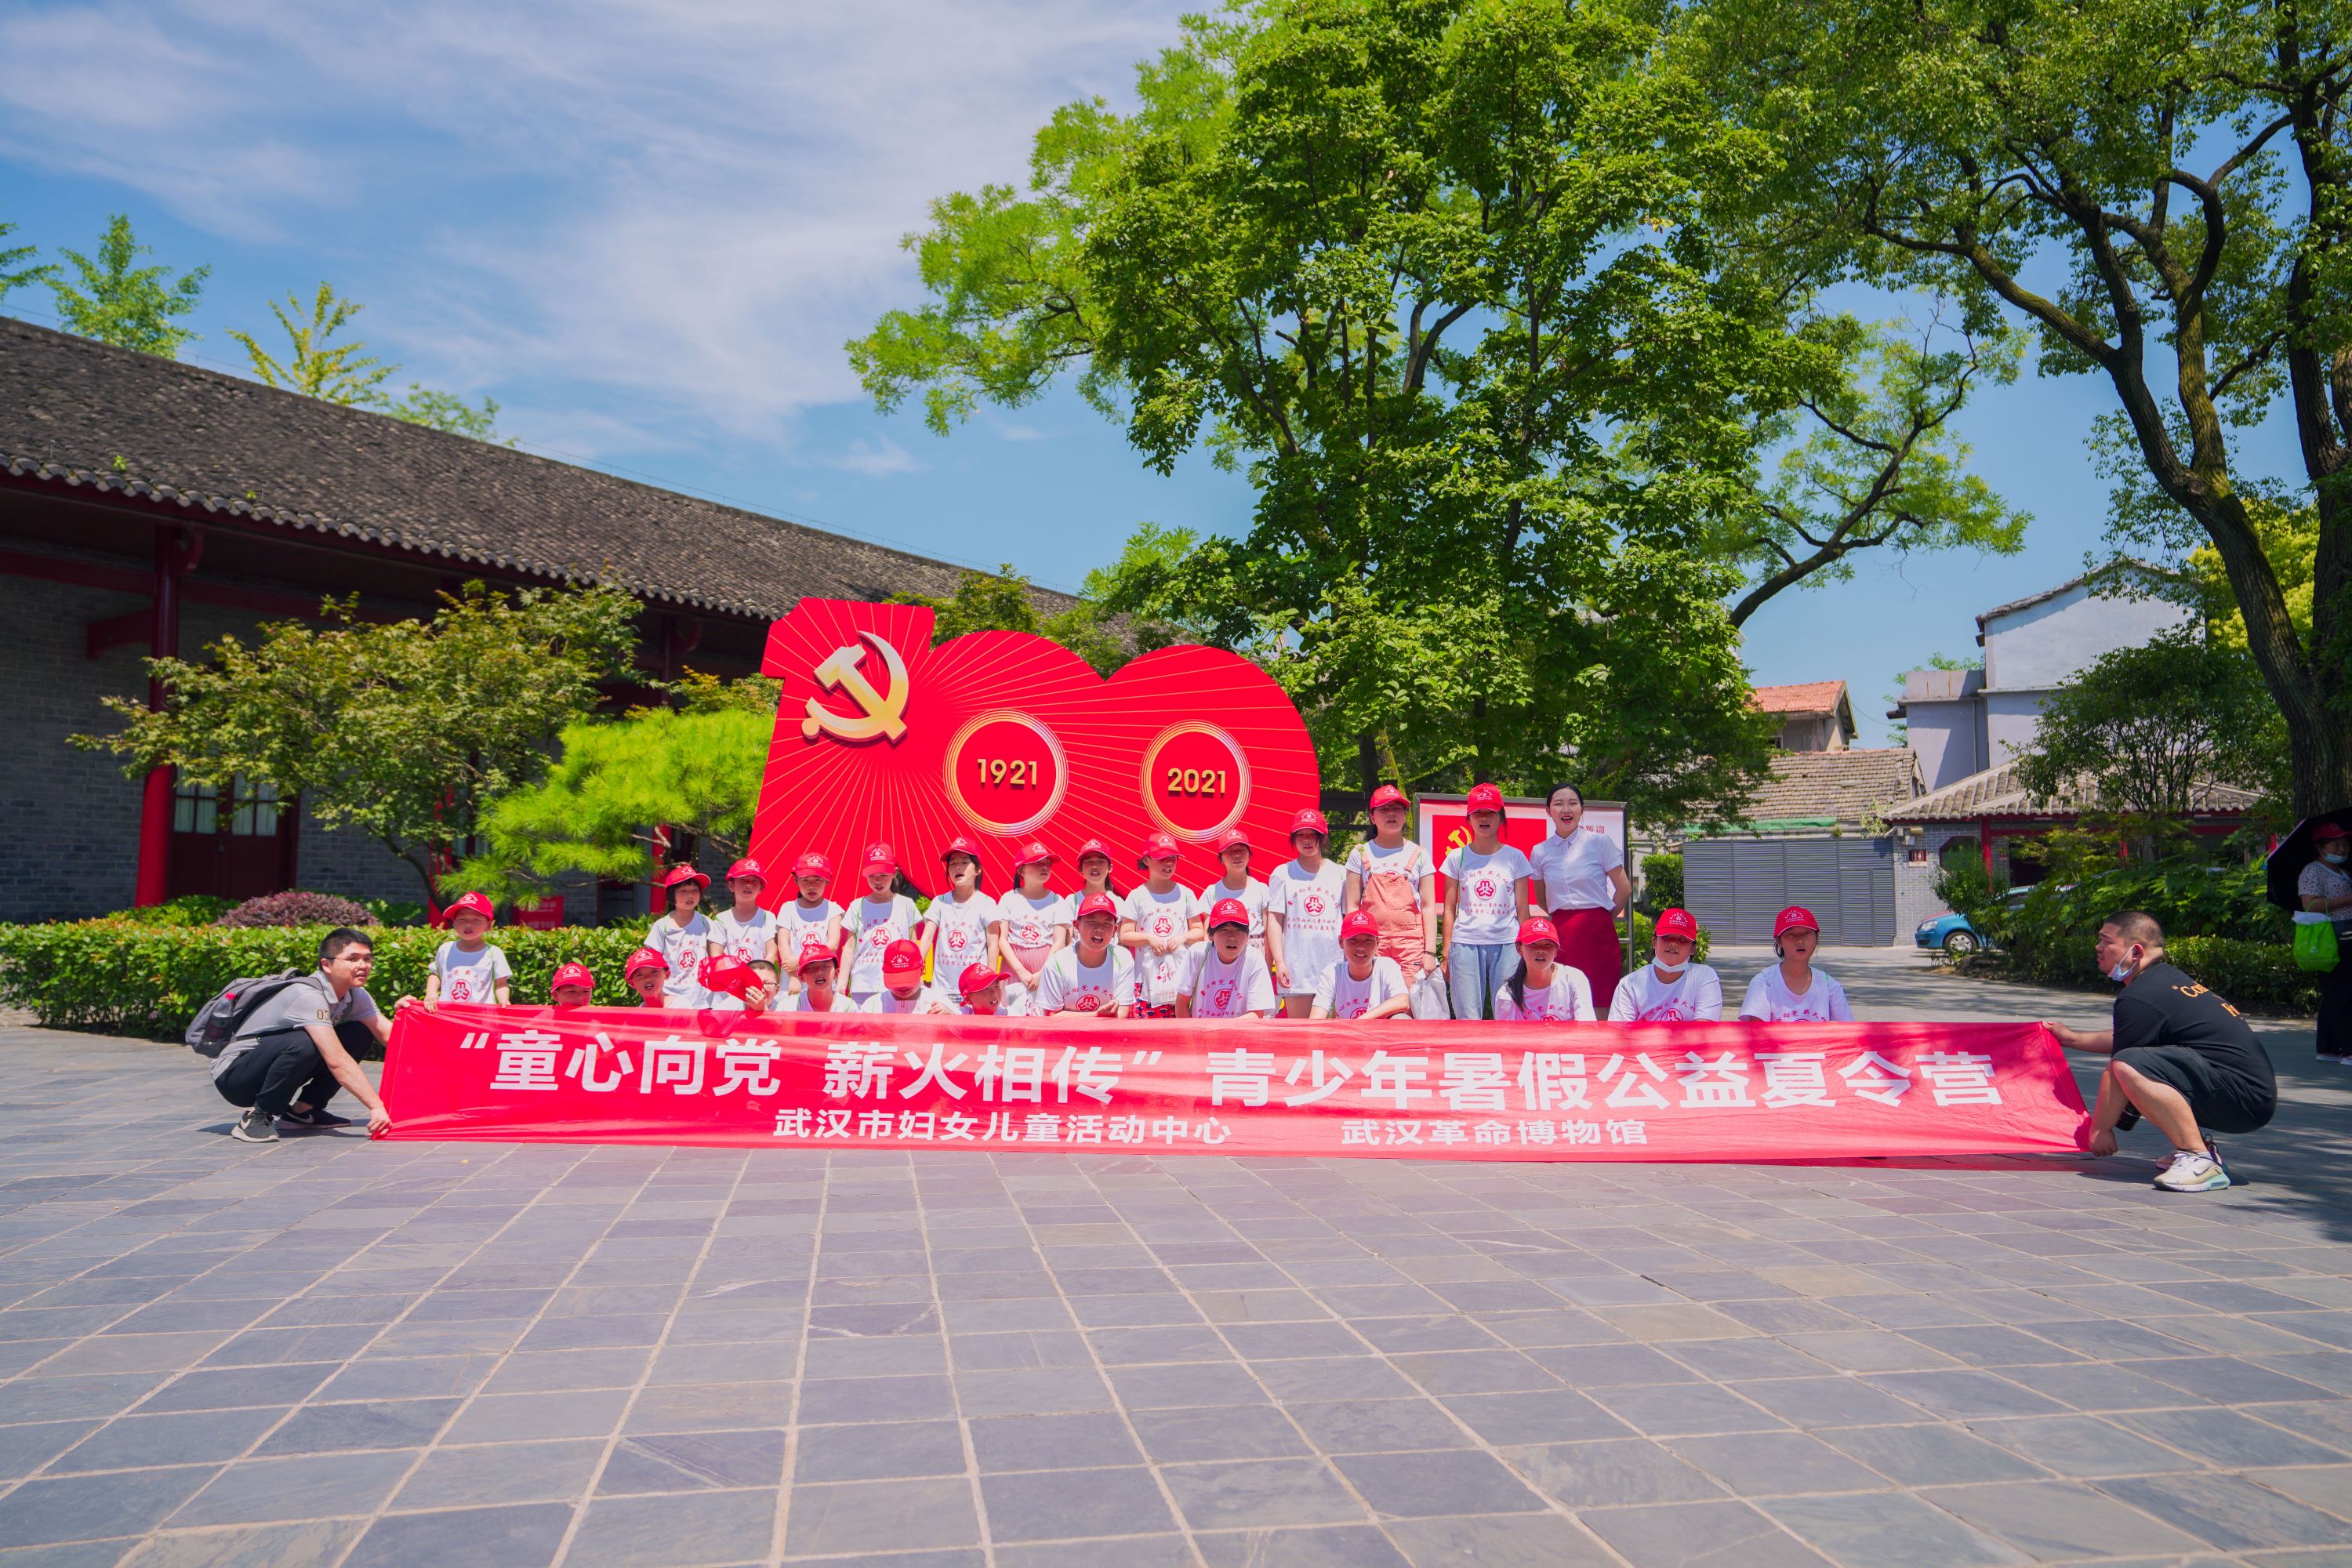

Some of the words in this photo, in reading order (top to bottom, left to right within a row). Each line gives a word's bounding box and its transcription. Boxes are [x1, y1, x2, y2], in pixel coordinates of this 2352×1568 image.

[978, 759, 1036, 785] 1921
[1168, 768, 1225, 793] 2021
[460, 1029, 782, 1097] “童心向党
[823, 1041, 1162, 1104] 薪火相传”
[1206, 1048, 2004, 1110] 青少年暑假公益夏令营
[772, 1108, 1231, 1145] 武汉市妇女儿童活动中心
[1341, 1119, 1648, 1145] 武汉革命博物馆
